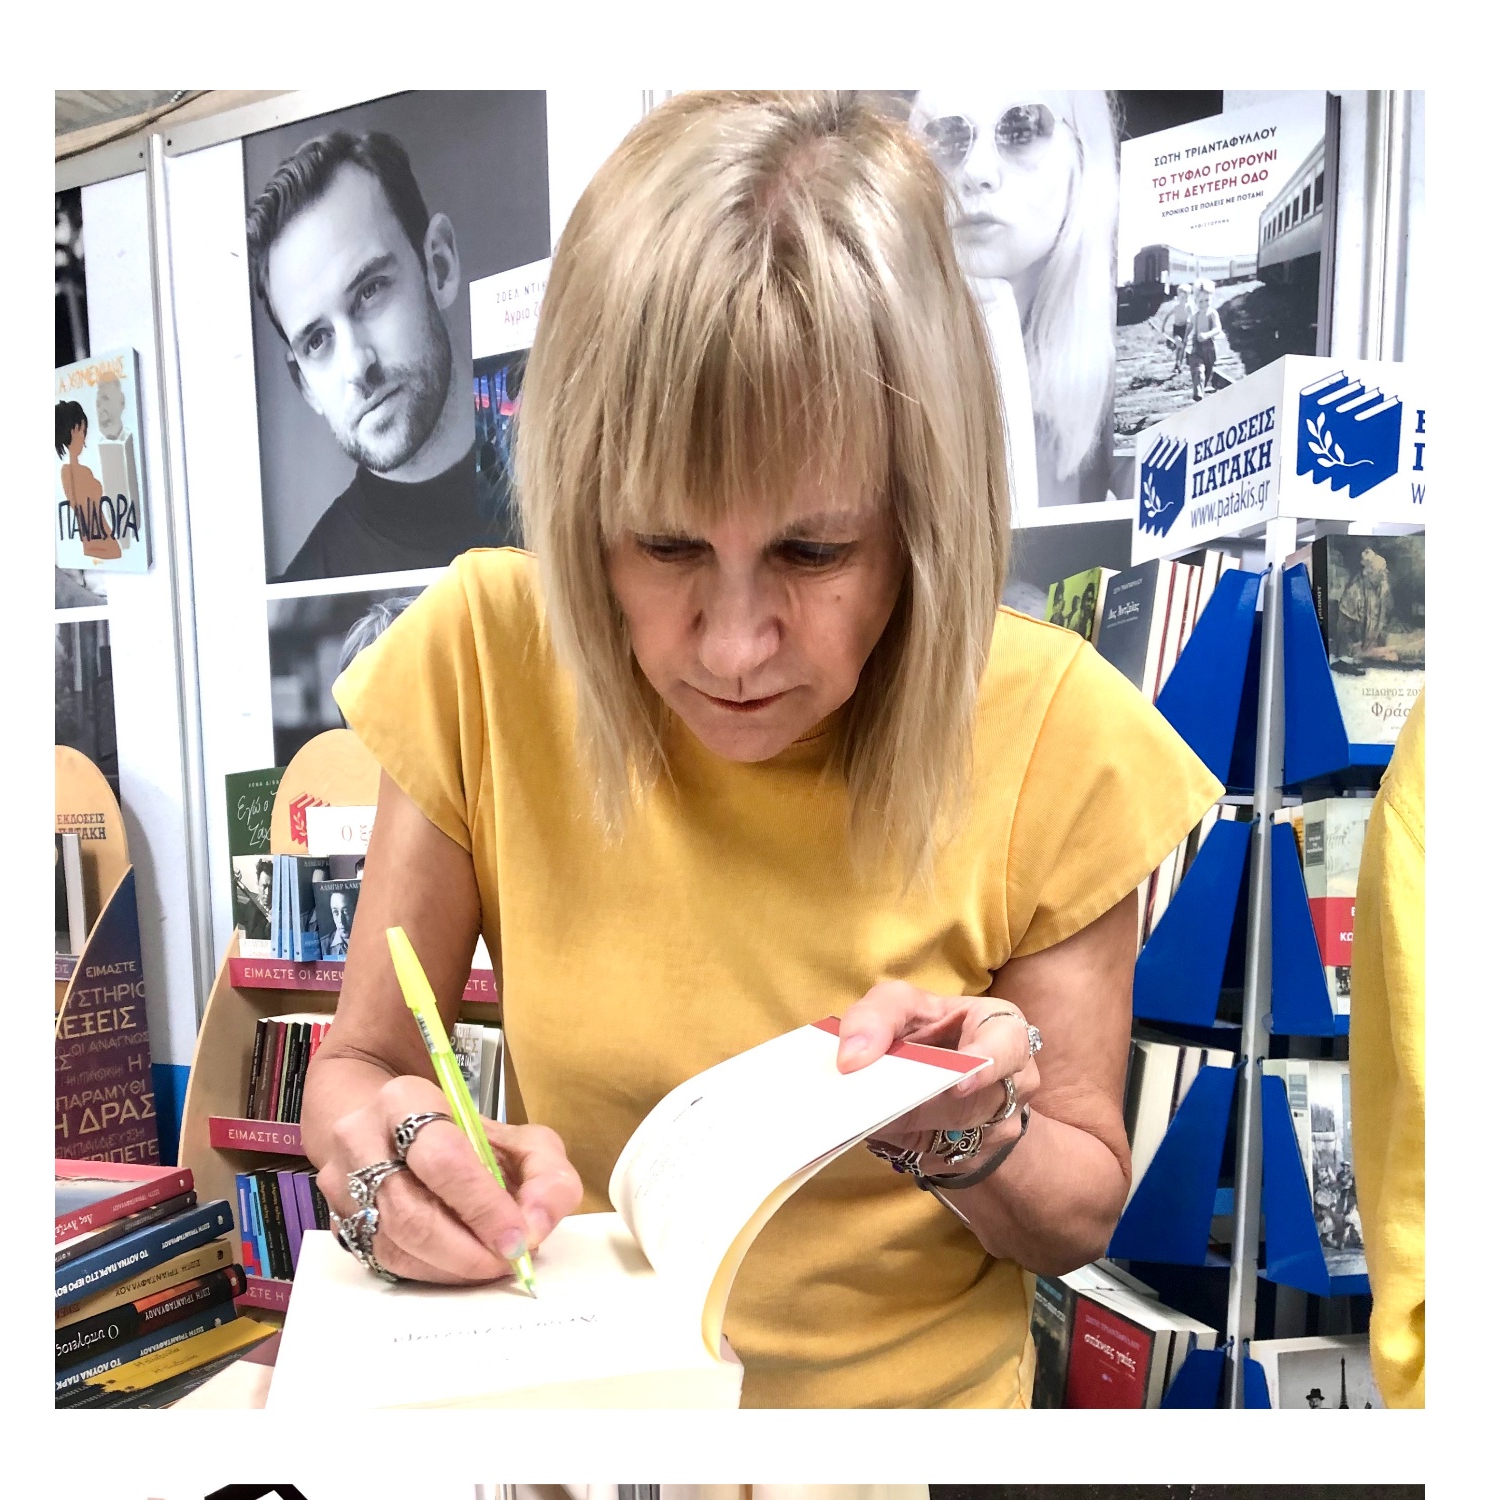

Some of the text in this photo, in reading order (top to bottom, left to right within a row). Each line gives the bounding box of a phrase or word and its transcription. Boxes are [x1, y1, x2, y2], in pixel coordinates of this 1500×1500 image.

[1154, 126, 1277, 167] ΣΩΤΗ ΤΡΙΑΝΤΑΦΥΛΛΟΥ
[1152, 149, 1278, 189] ΤΟ ΤΥΦΛΟ ΓΟΥΡΟΥΝΙ
[1158, 170, 1269, 204] ΣΤΗ ΔΕΥΤΕΡΗ ΟΔΟ
[1161, 190, 1264, 218] ΧΡΟΝΙΚΟ ΣΕ ΠΟΛΕΙΣ ΜΕ ΠΟΤΑΜΙ
[1193, 405, 1276, 466] ΕΚΔΟΣΕΙΣ
[1191, 438, 1273, 500] ΠΑΤΑΚΗ
[1190, 478, 1271, 529] www.patakis.gr
[58, 494, 140, 543] ΠΑΝΔΩΡΑ
[1361, 687, 1404, 698] ΙΣΙΔΩΡΟΣ
[57, 814, 105, 825] ΕΚΔΟΣΕΙΣ
[86, 960, 137, 978] ΕΙΜΑΣΤΕ
[244, 967, 312, 981] ΕΙΜΑΣΤΕ ΟΙ
[228, 1128, 296, 1145] ΕΙΜΑΣΤΕ ΟΙ
[100, 1262, 116, 1277] ΠΑΡΚ
[116, 1252, 138, 1269] ΛΟΥΝΑ
[108, 1324, 119, 1340] Ο
